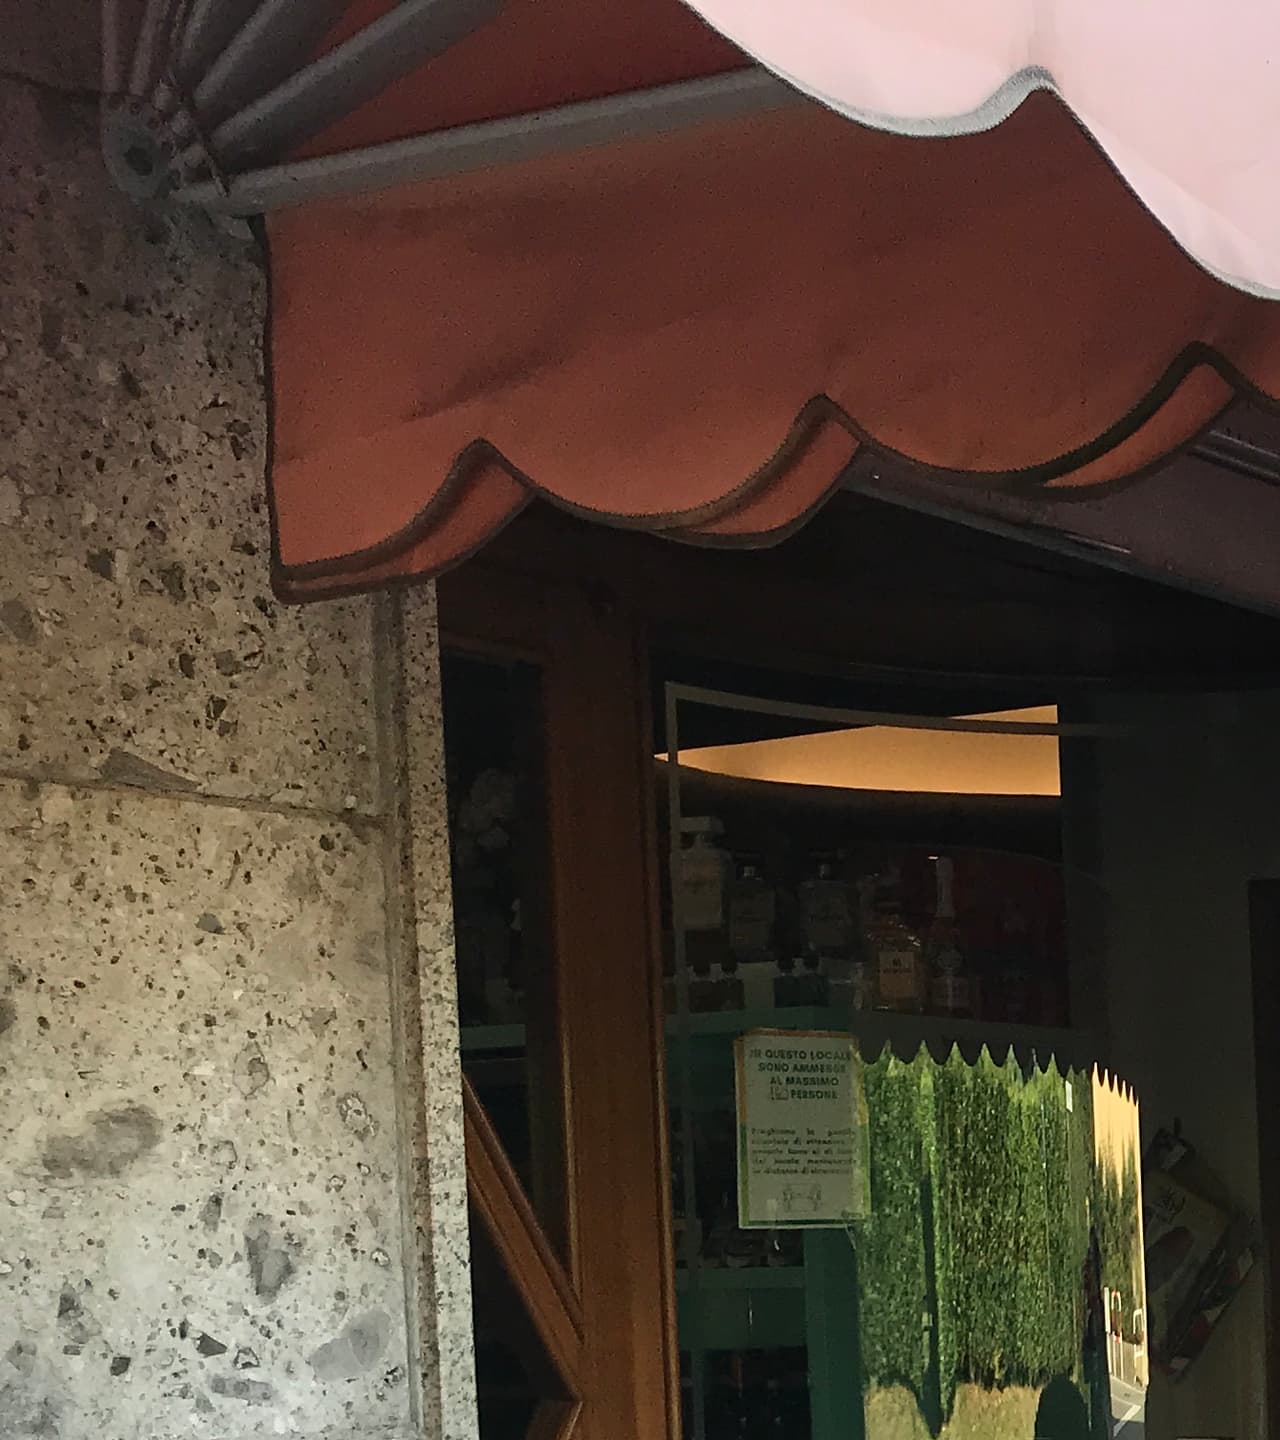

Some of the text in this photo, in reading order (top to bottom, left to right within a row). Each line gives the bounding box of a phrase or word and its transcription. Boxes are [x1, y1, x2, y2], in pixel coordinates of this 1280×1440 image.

[765, 1049, 807, 1060] QUESTO
[810, 1050, 851, 1061] LOCALE
[758, 1062, 789, 1073] SONO
[770, 1076, 839, 1086] AL MASSIMO
[791, 1089, 838, 1100] PERSONE
